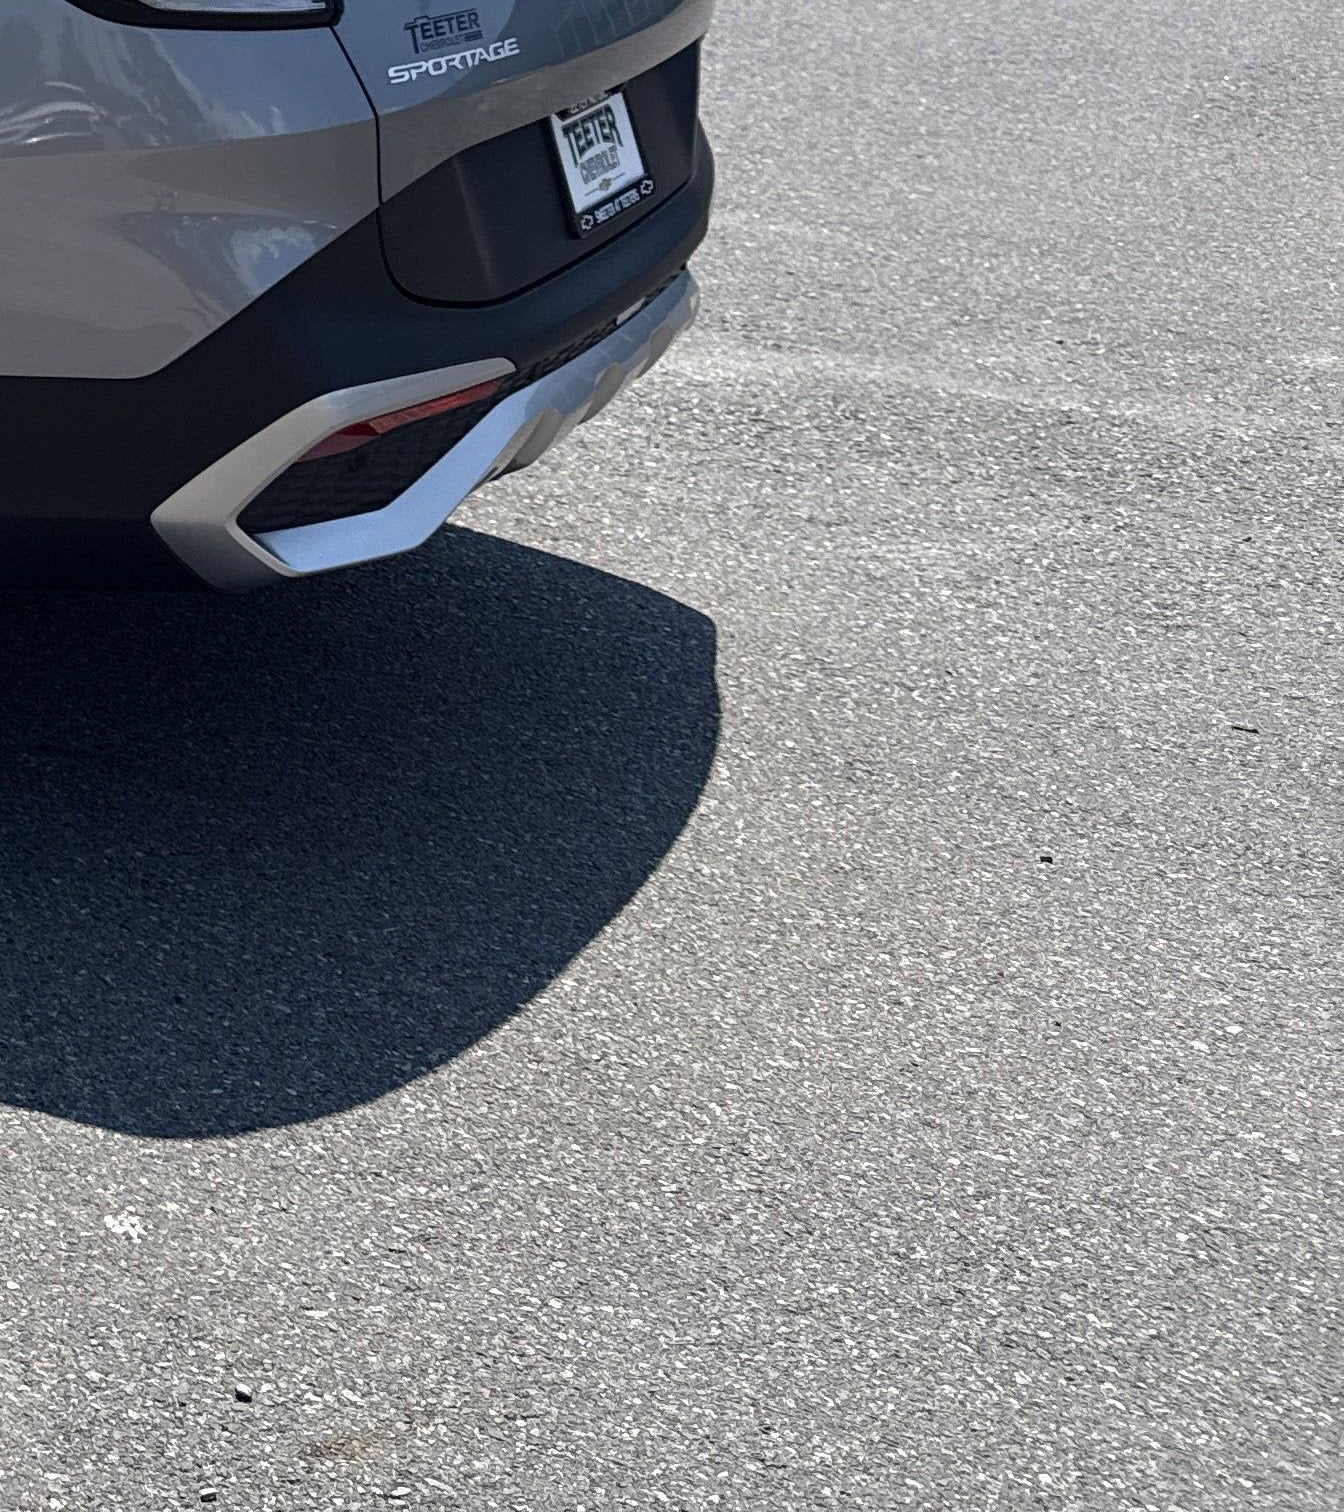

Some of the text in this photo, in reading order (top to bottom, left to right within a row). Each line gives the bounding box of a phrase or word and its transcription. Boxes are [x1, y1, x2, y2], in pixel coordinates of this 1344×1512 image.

[403, 8, 481, 54] TEETER
[387, 37, 521, 84] SPORTAGE
[561, 103, 624, 169] TEETER
